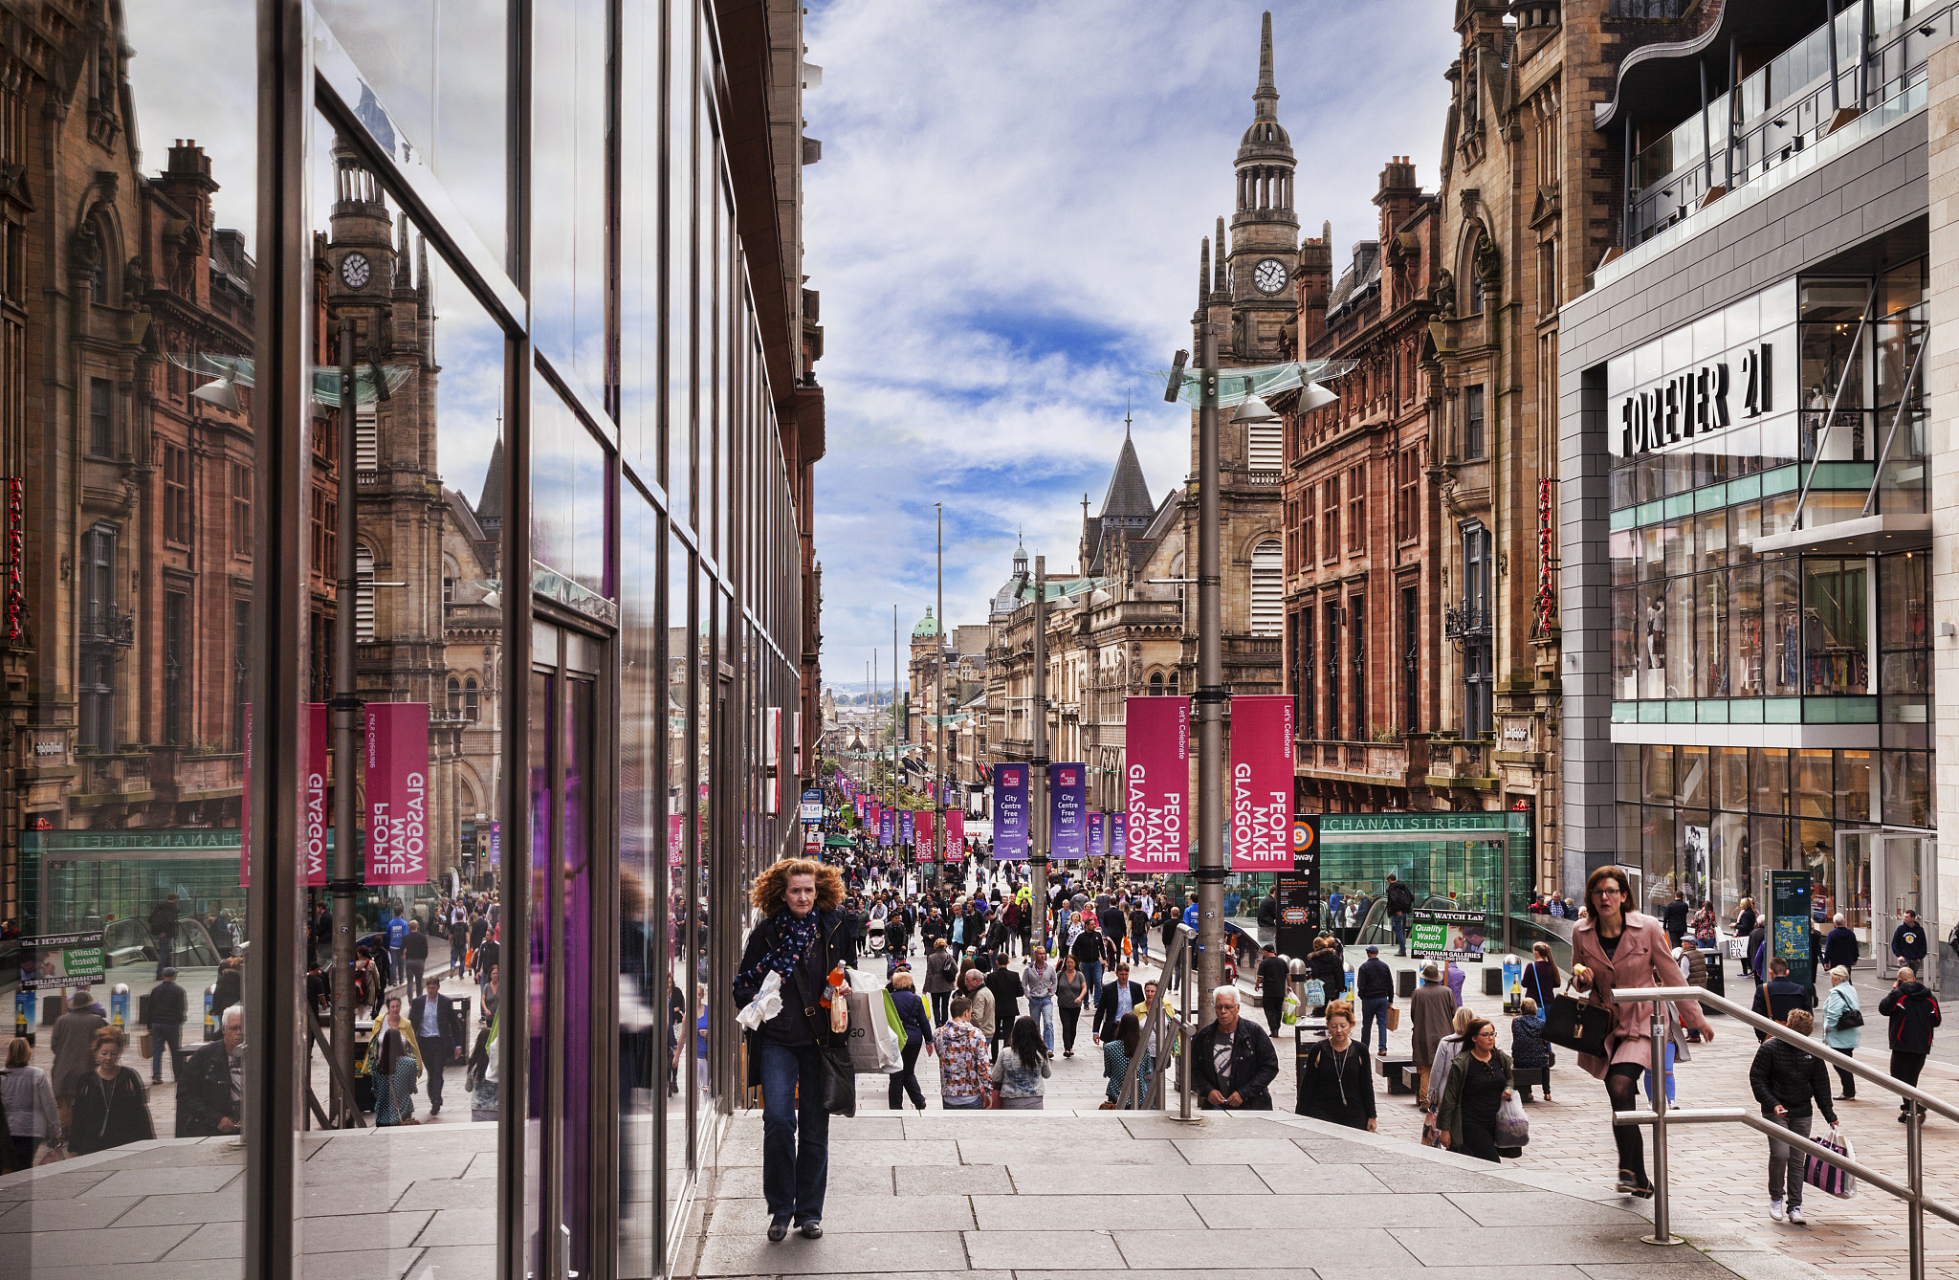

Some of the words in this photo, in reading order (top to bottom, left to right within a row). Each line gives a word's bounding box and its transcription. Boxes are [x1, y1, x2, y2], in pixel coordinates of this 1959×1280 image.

[1620, 363, 1731, 458] FOREVER
[1740, 343, 1774, 418] 21
[1539, 478, 1552, 521] Hard
[1538, 528, 1552, 578] Rock
[1540, 584, 1552, 632] Cafe
[1284, 723, 1292, 758] Celebrate
[1129, 764, 1145, 862] GLASGOW
[1164, 793, 1180, 862] PEOPLE
[1235, 763, 1251, 861] GLASGOW
[1252, 806, 1269, 861] MAKE
[1270, 792, 1286, 861] PEOPLE
[1322, 818, 1404, 830] CHANAN
[1410, 818, 1480, 829] STREET
[1147, 808, 1162, 862] MAKE
[1294, 853, 1314, 862] bway
[1296, 831, 1302, 841] S
[1414, 941, 1442, 949] Repairs
[1416, 925, 1443, 933] Quality
[1731, 939, 1744, 948] RIV
[1731, 948, 1741, 957] ER
